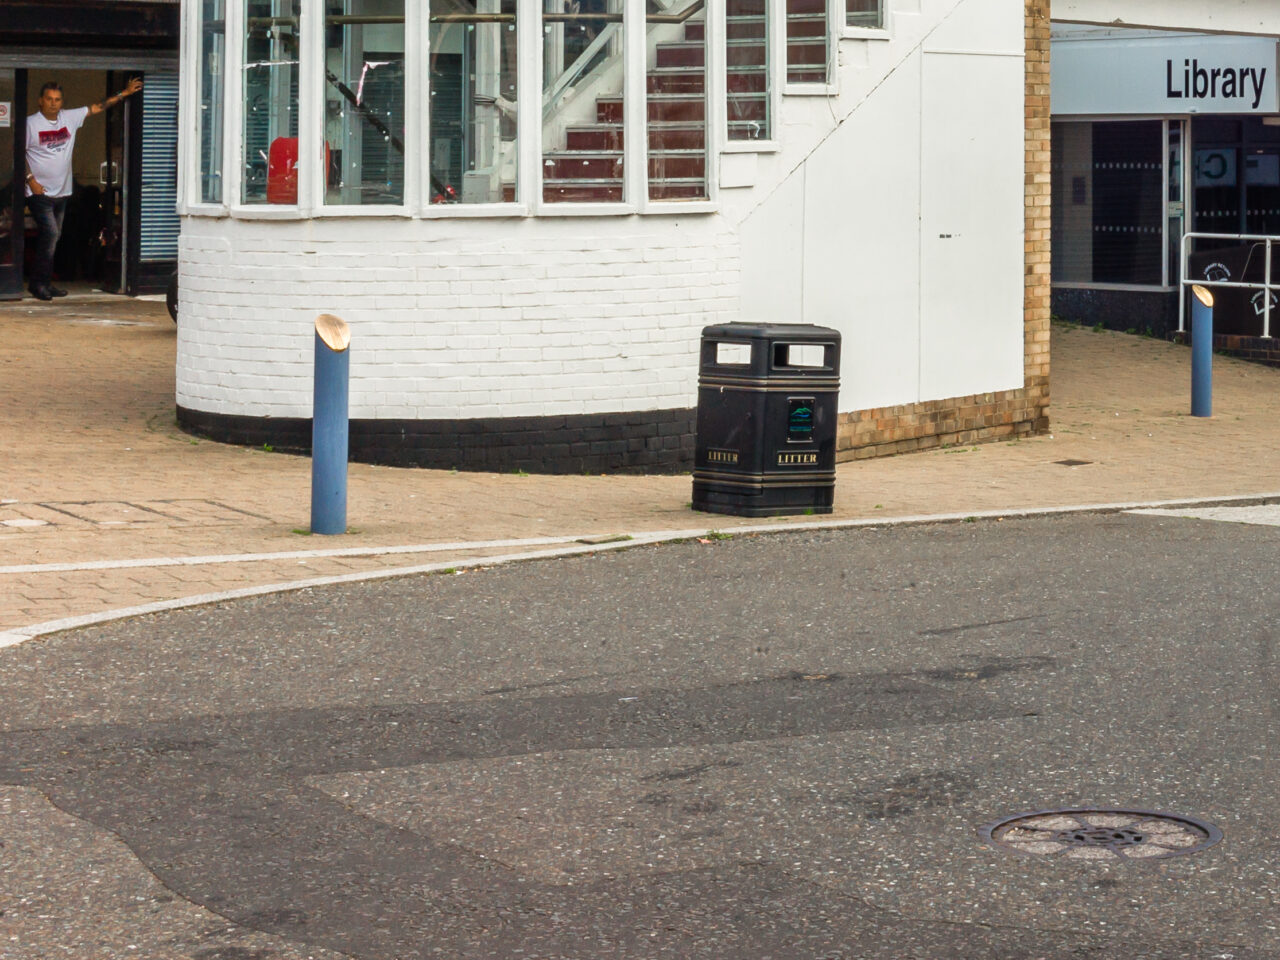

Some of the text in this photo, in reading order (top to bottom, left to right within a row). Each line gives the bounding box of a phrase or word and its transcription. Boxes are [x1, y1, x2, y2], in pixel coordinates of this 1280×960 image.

[1166, 58, 1267, 109] Library
[708, 451, 738, 463] LITTER
[778, 453, 817, 464] LITTER
